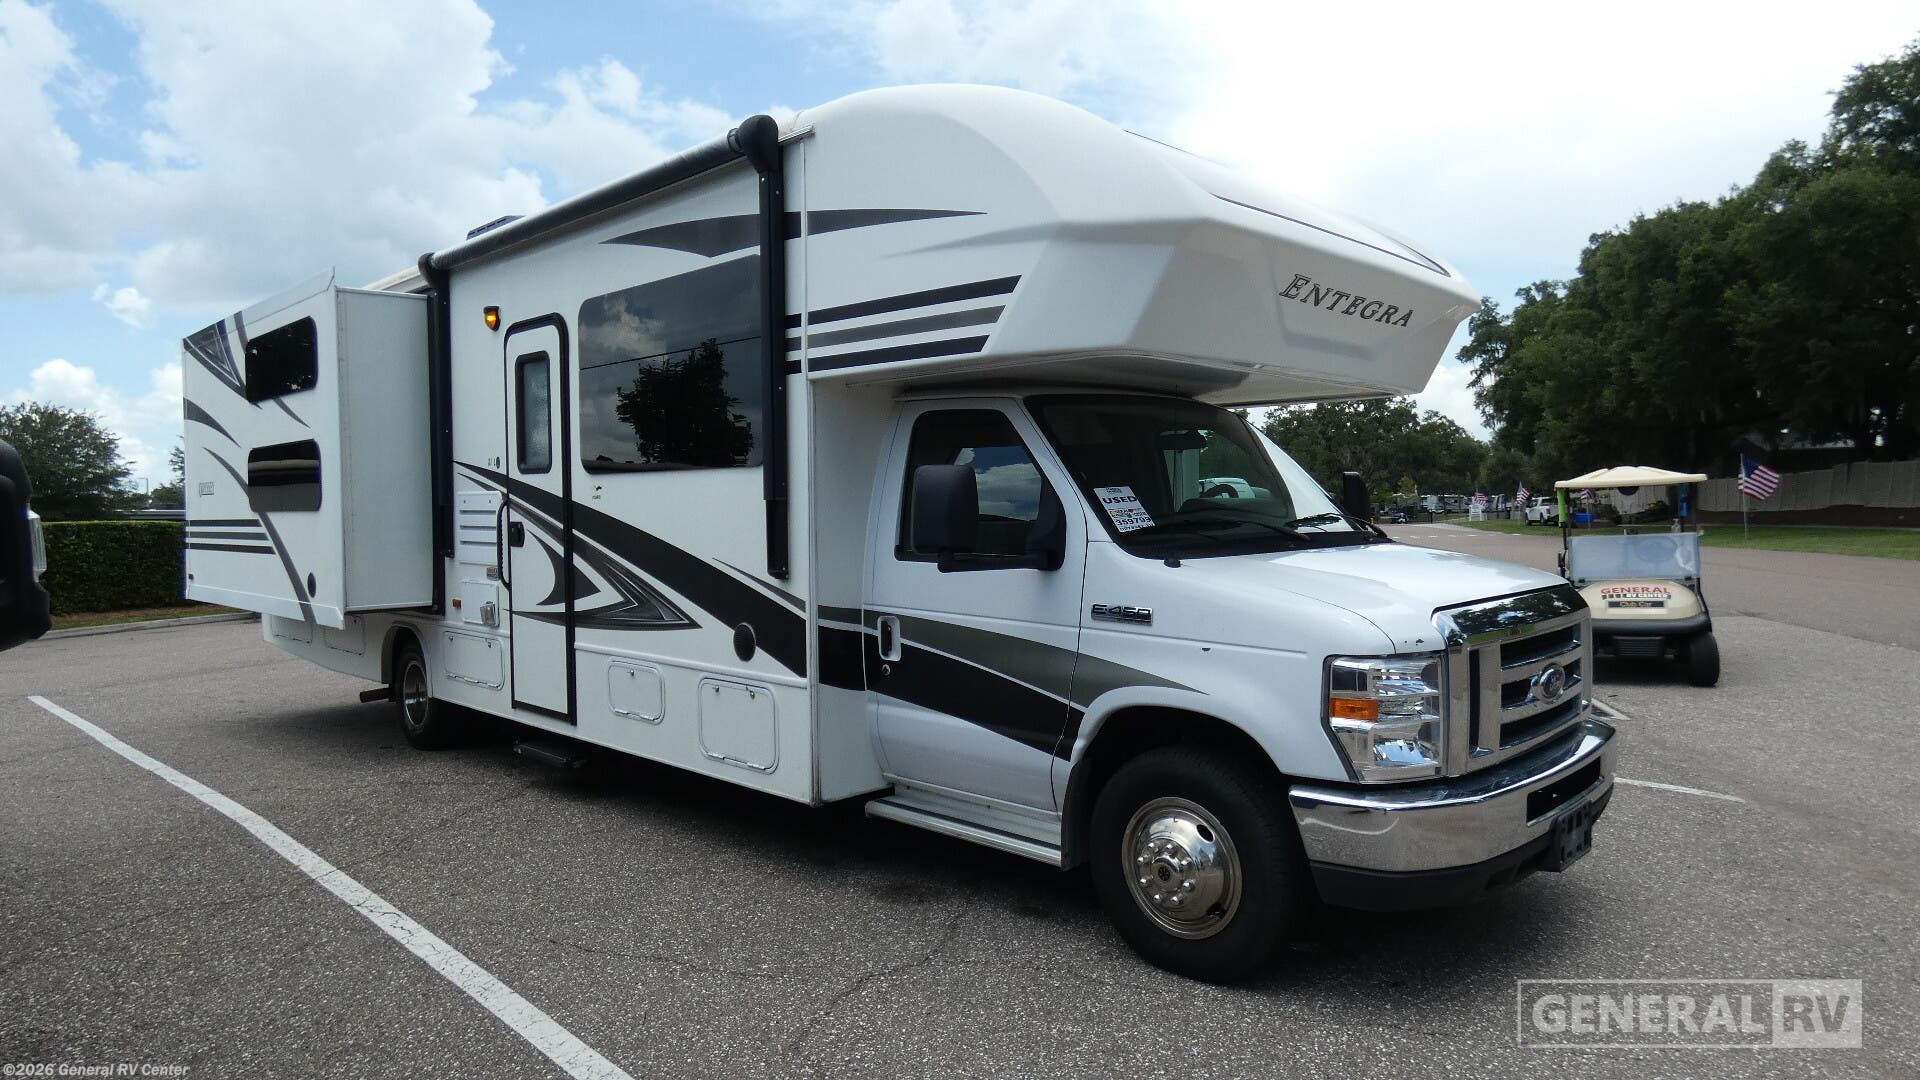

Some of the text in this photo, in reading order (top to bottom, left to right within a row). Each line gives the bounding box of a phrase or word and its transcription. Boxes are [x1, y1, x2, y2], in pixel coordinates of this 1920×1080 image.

[1278, 273, 1415, 328] ENTEGRA
[1102, 495, 1138, 505] USED
[1601, 586, 1671, 594] GENERAL
